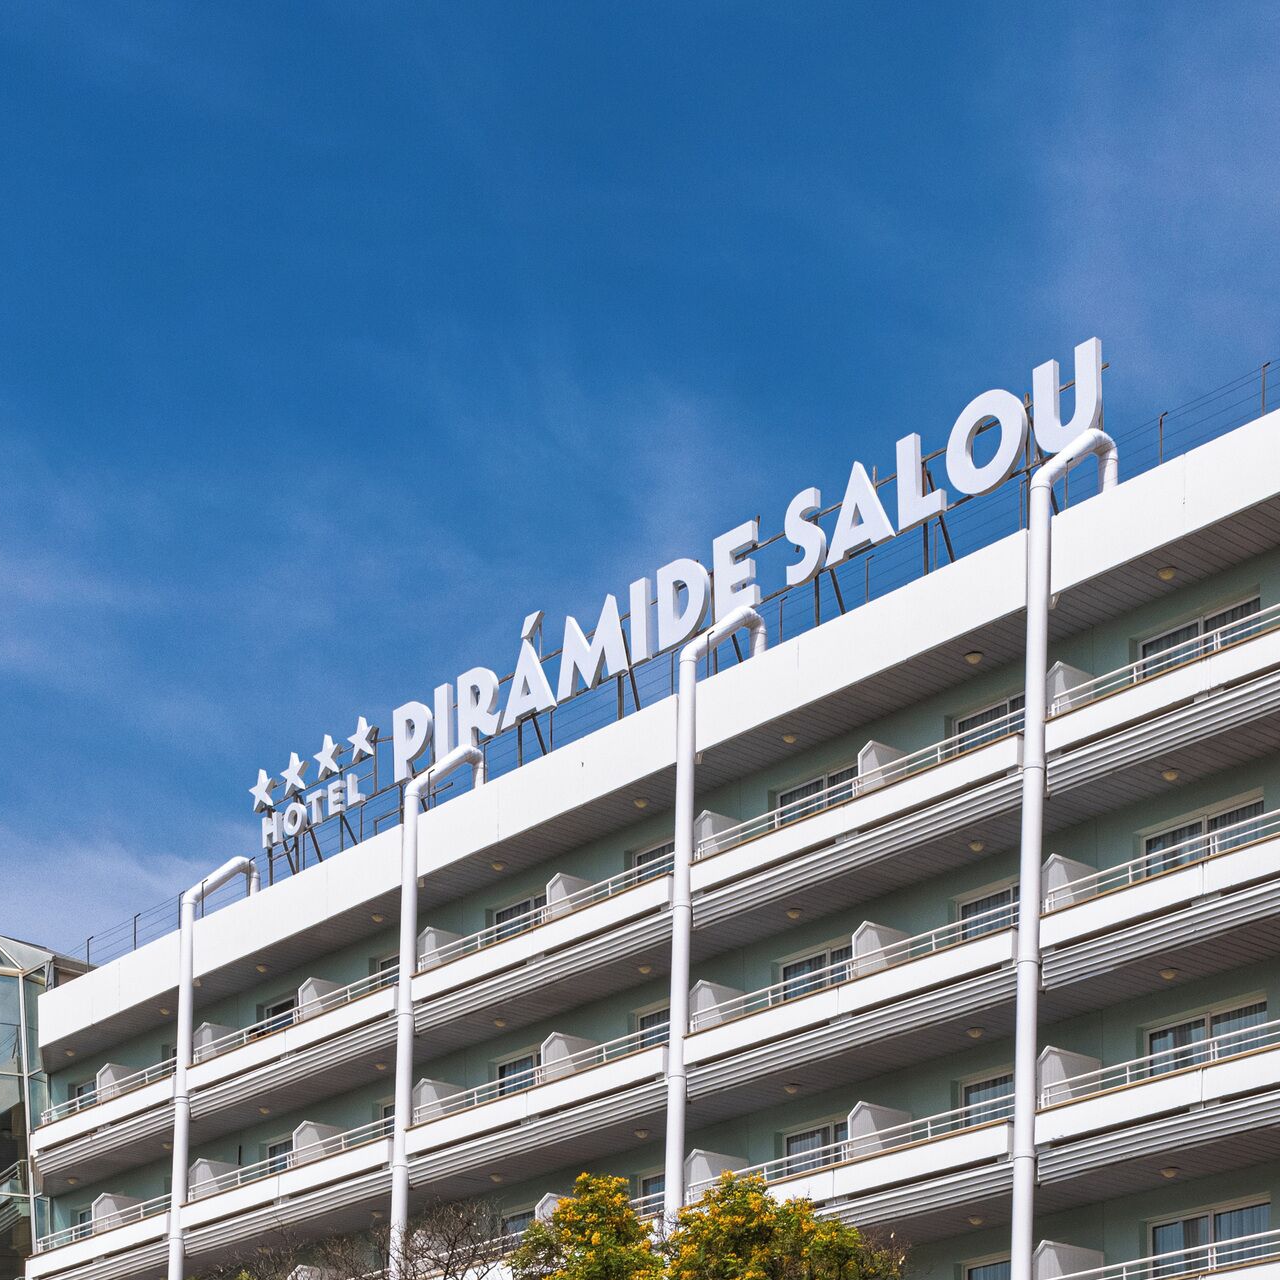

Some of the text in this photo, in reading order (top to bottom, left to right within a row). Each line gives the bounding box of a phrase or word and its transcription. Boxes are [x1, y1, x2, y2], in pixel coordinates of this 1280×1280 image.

[392, 336, 1102, 784] PIRÁMIDE SALOU
[261, 772, 366, 850] HOTEL
